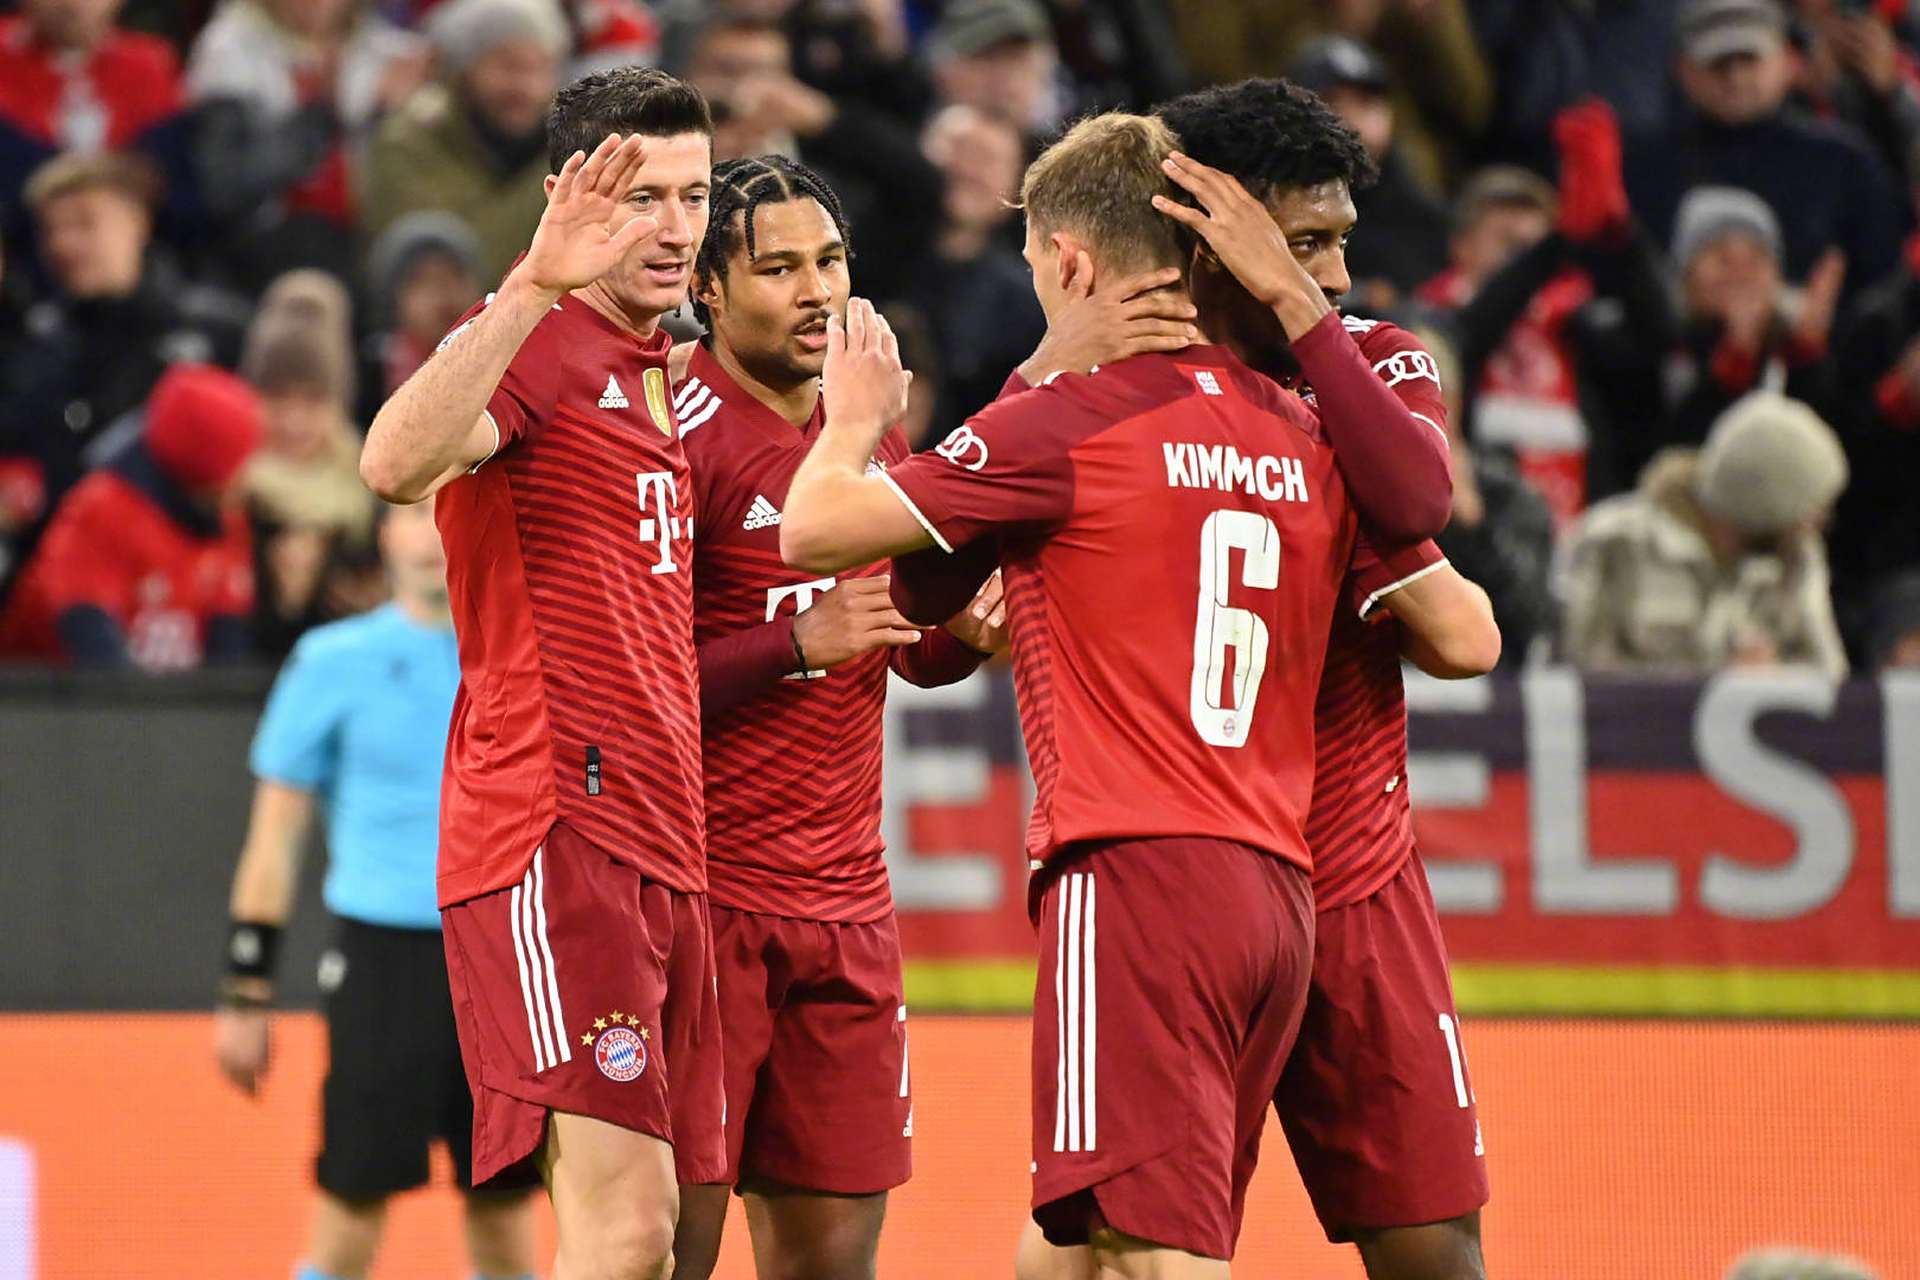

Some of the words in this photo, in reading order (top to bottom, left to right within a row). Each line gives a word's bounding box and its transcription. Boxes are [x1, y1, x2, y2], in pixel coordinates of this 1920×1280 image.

[598, 397, 630, 409] adidas
[1190, 509, 1280, 748] 6
[607, 1031, 641, 1051] BAYERN
[1439, 1012, 1476, 1108] 1
